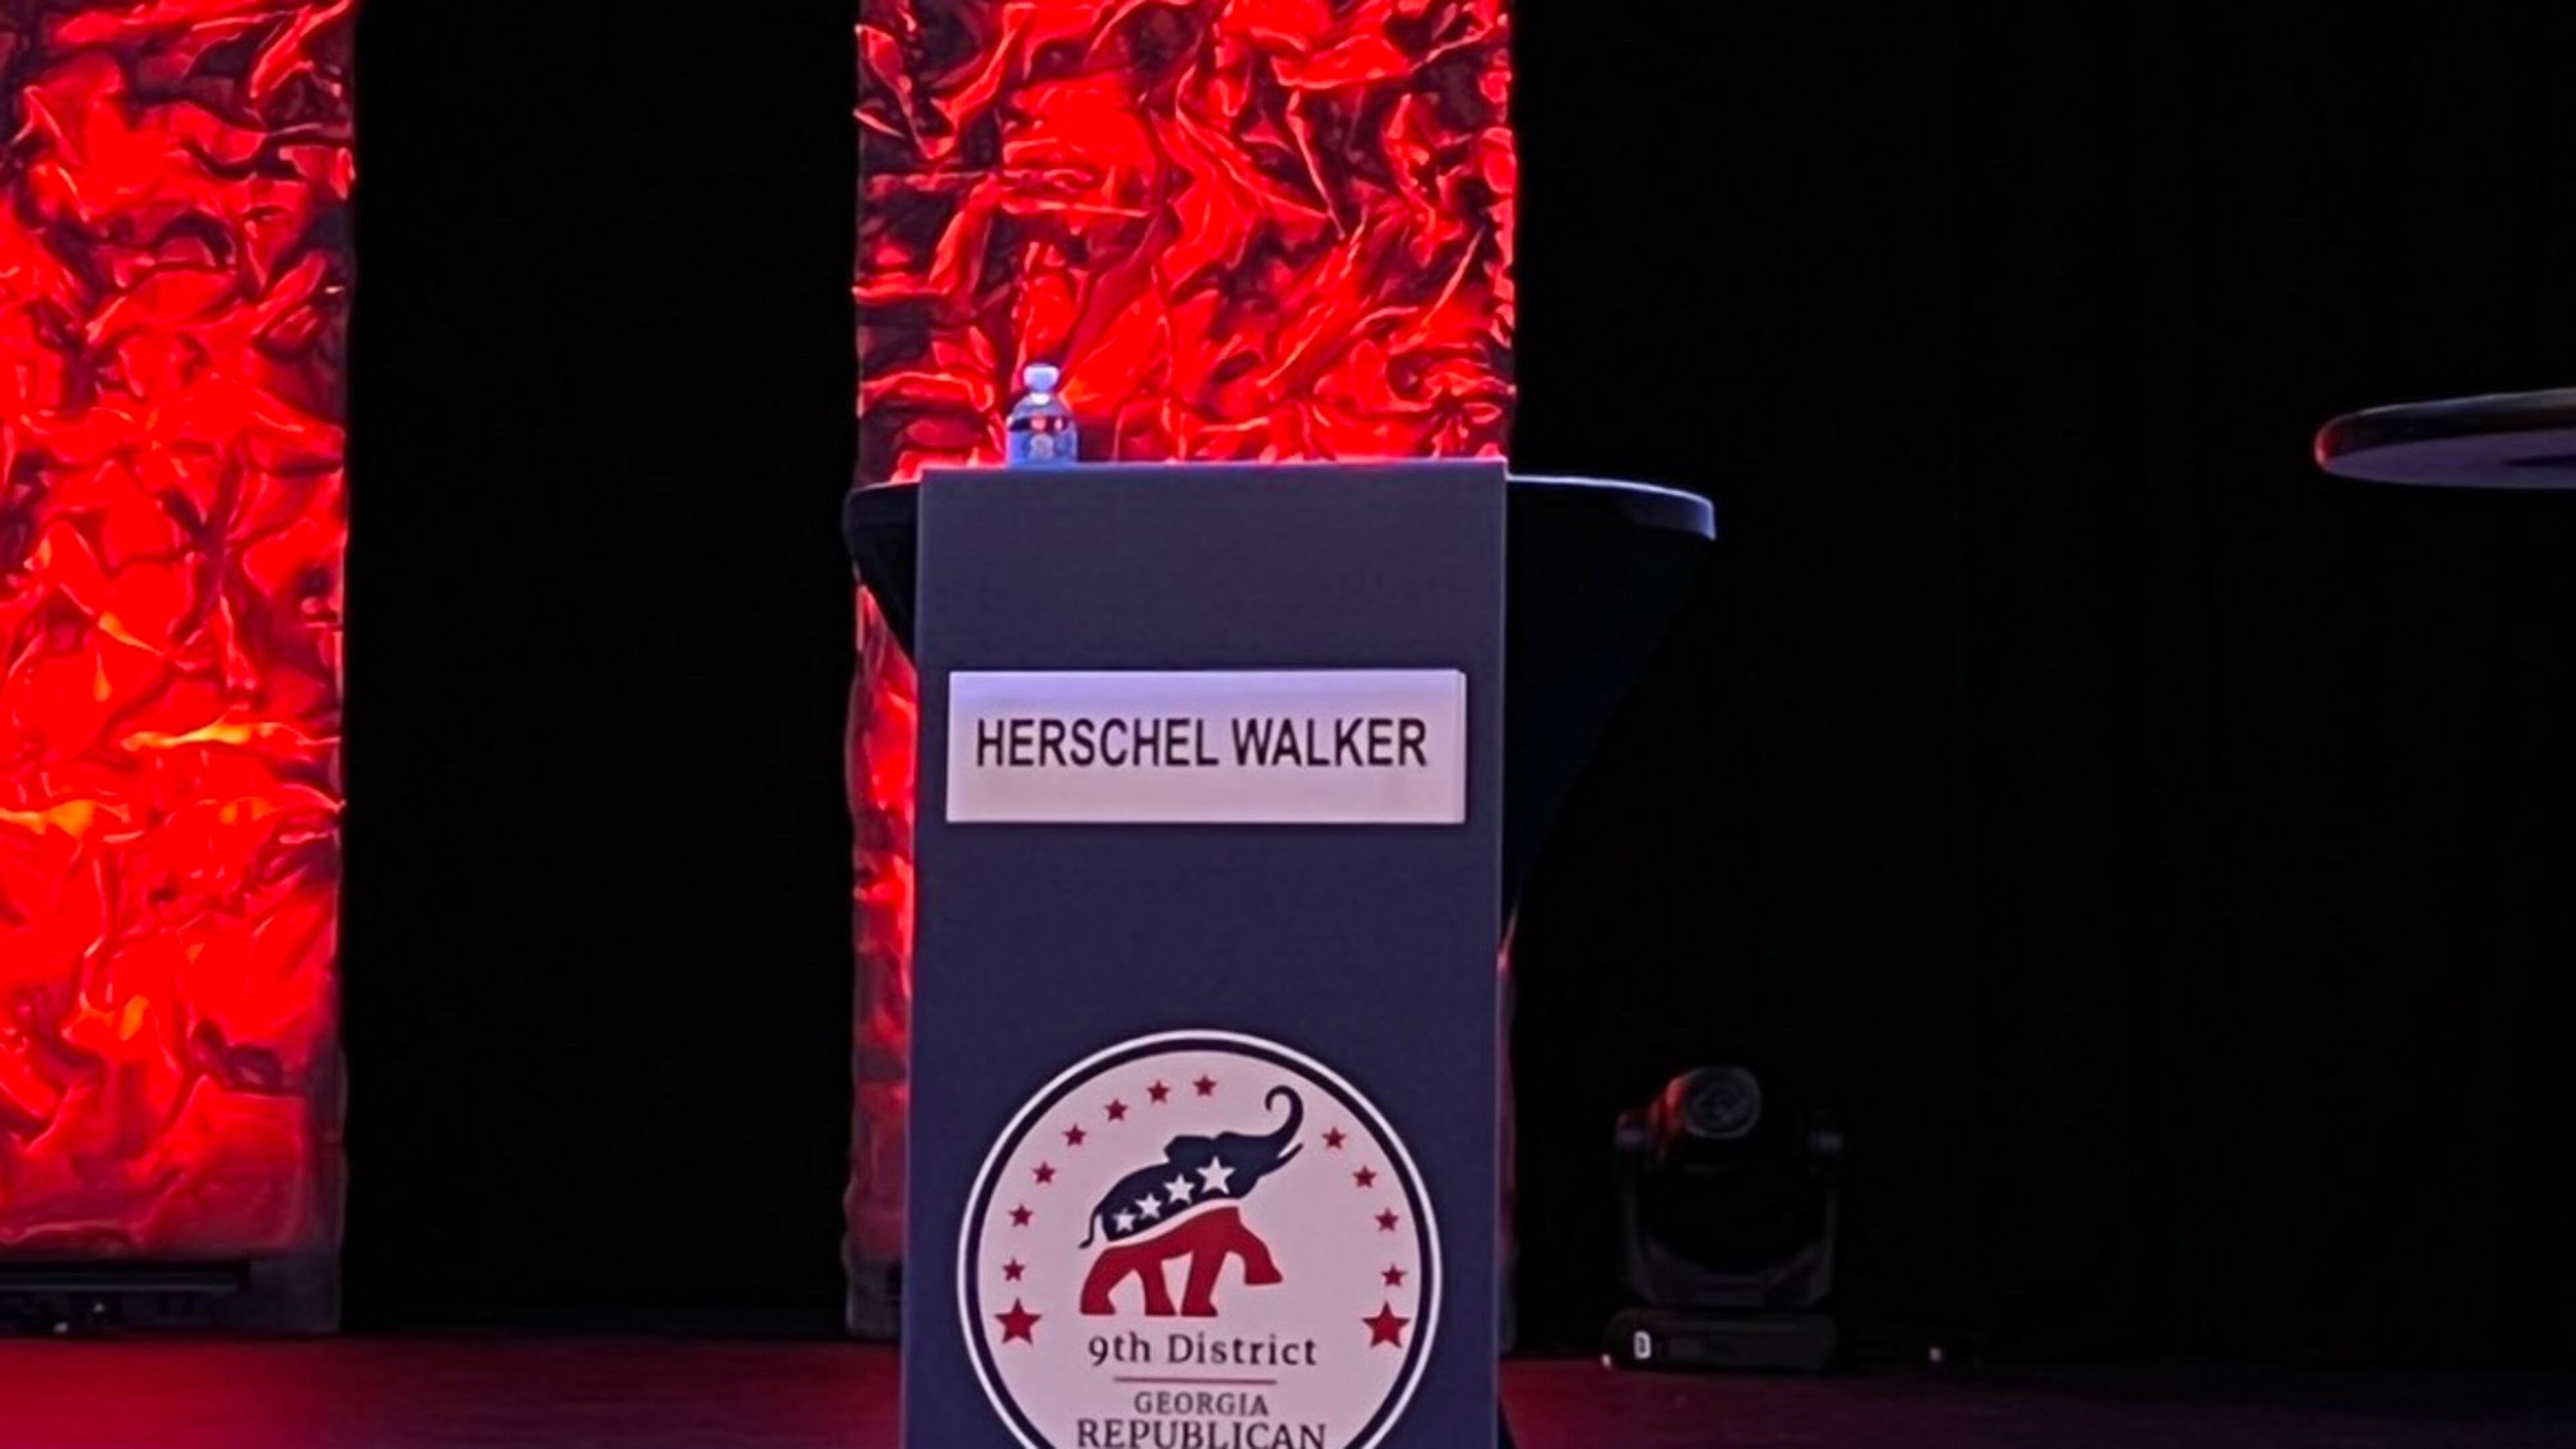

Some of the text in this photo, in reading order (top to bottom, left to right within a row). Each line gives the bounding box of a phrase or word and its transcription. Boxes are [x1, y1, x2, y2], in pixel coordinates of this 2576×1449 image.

[976, 716, 1428, 768] HERSCHEL WALKER
[1088, 1331, 1317, 1366] 9th District
[1133, 1391, 1269, 1417] GEORGIA
[1077, 1418, 1326, 1449] REPUBLICAN
